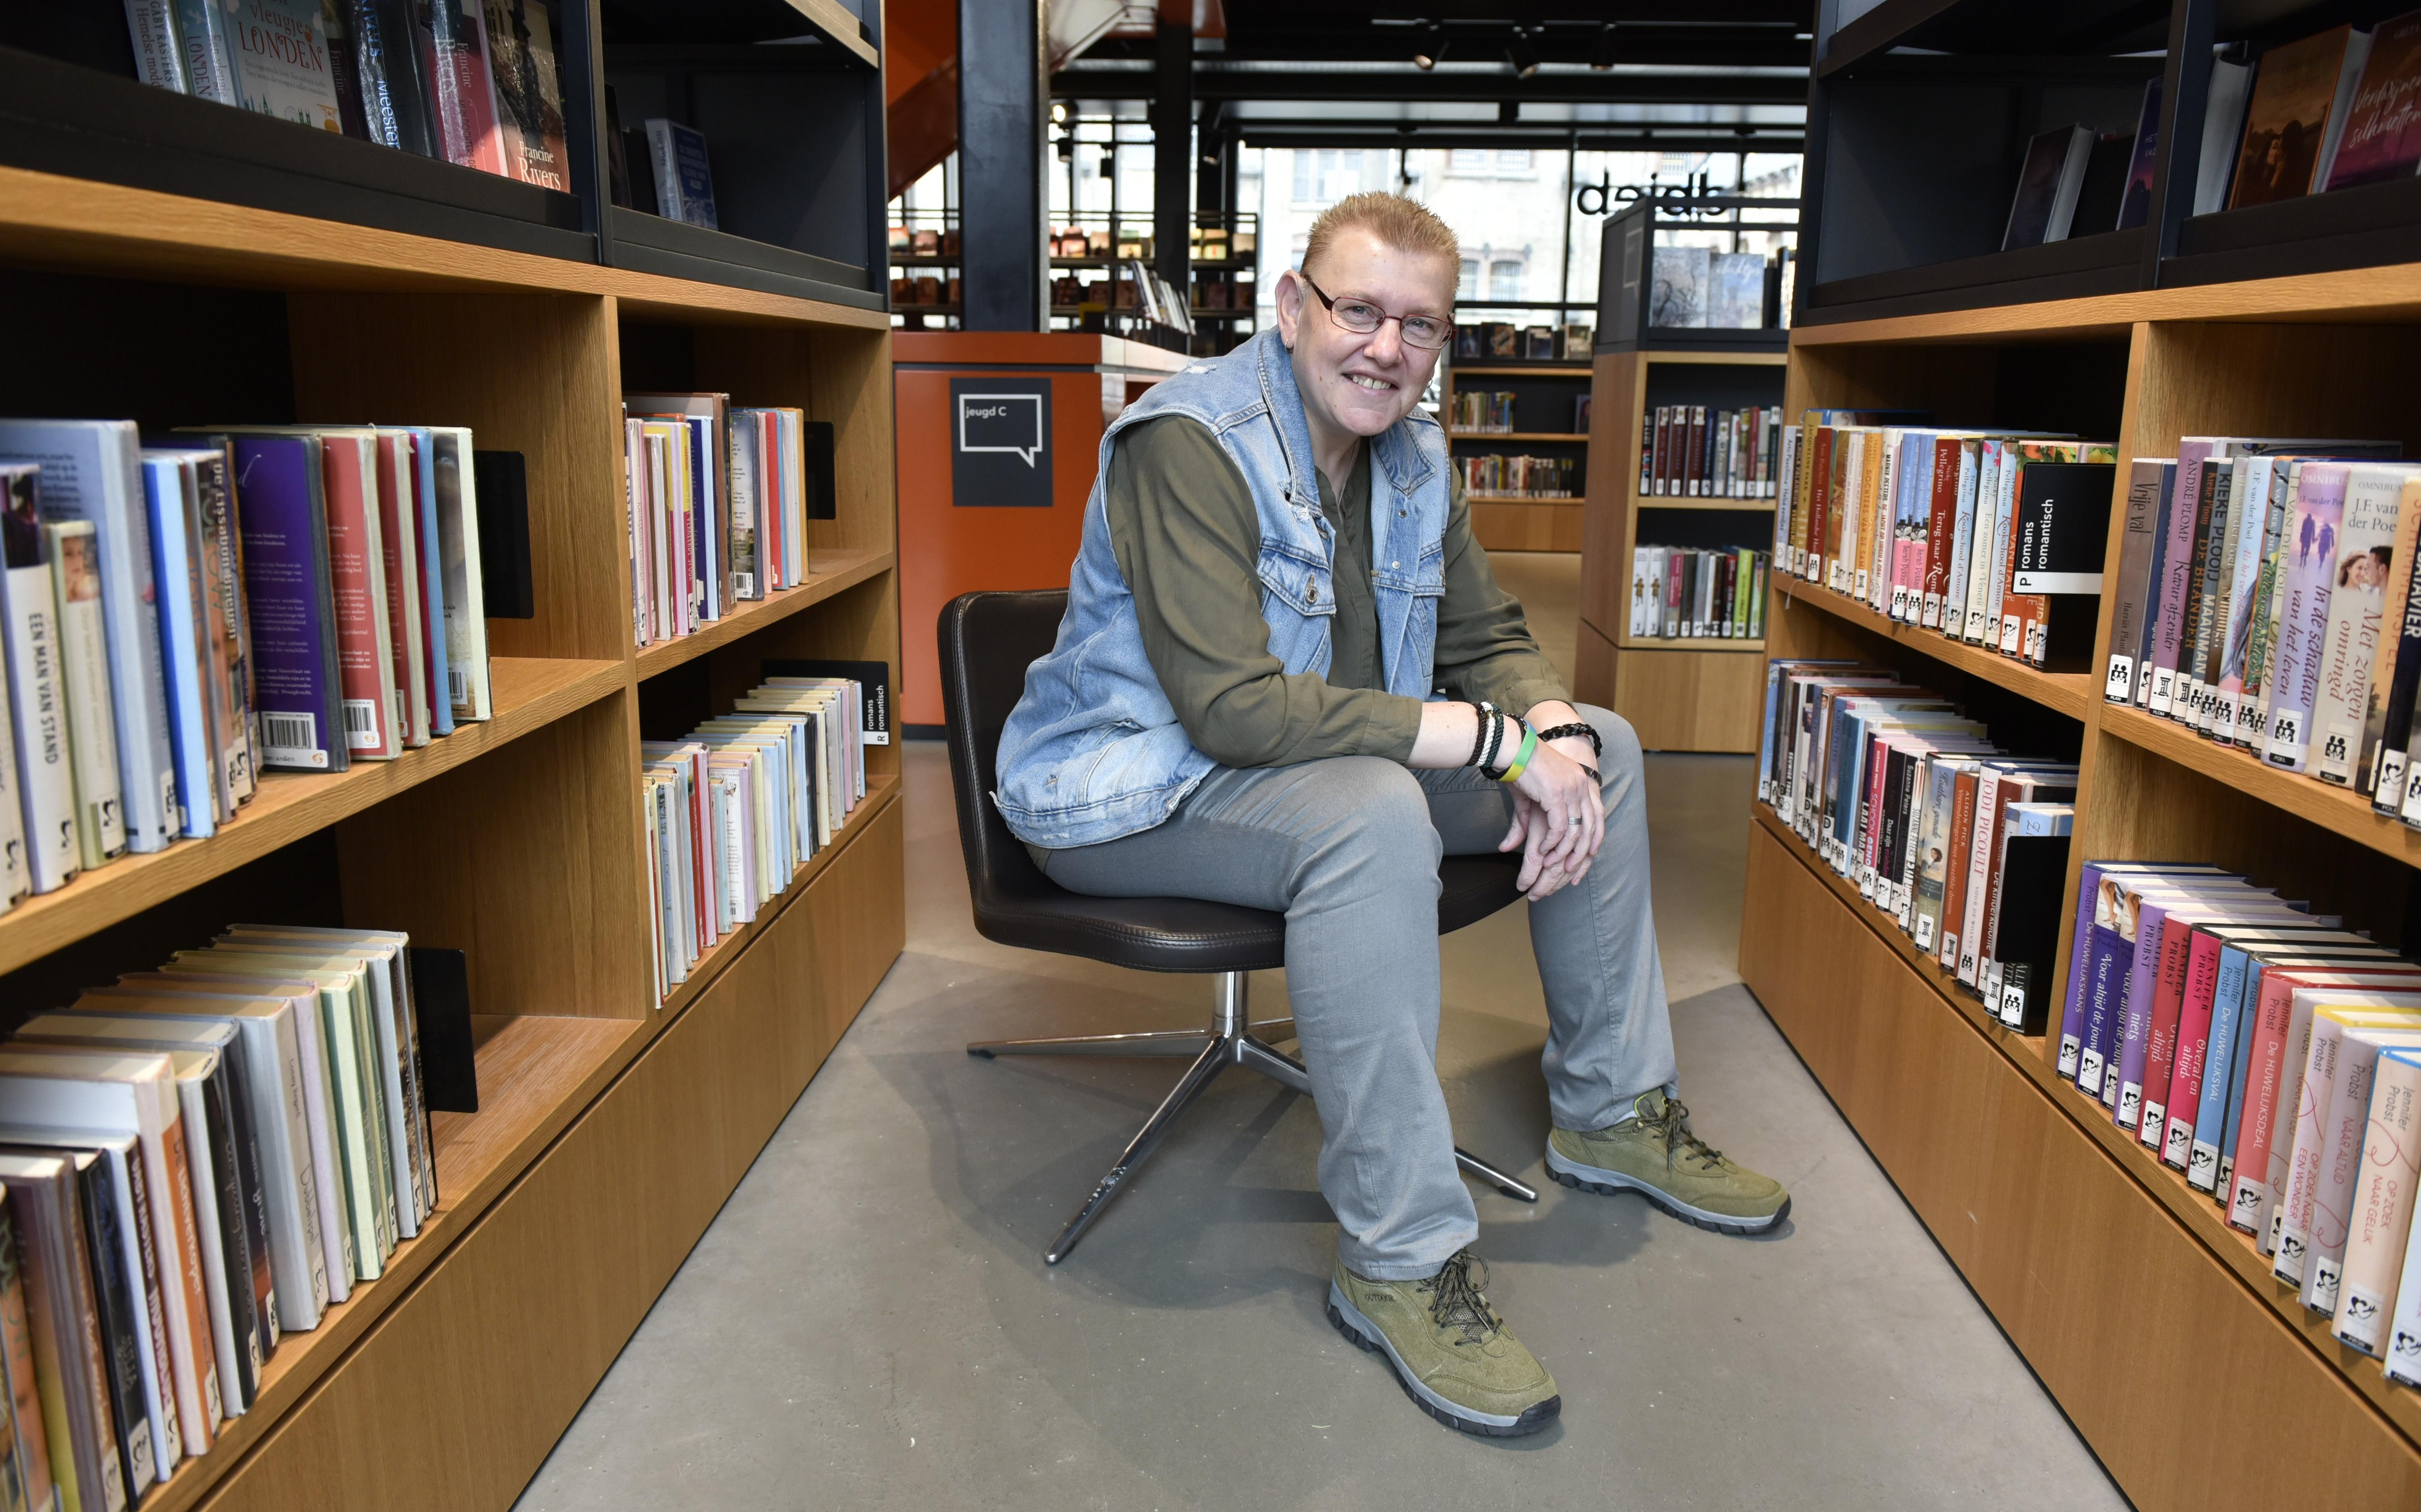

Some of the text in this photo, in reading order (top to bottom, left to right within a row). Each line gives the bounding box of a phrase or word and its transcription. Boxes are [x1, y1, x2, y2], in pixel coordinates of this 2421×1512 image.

[137, 8, 154, 54] Hemelse
[250, 0, 303, 36] vleugje
[187, 35, 212, 96] LONDEN
[239, 21, 323, 72] LONDEN
[457, 42, 473, 88] Francine
[518, 157, 561, 191] Rivers
[519, 141, 554, 163] Francine
[965, 406, 1006, 419] jeugd C
[1863, 469, 1872, 514] DOCHTERS
[1936, 449, 1948, 493] Pellegrino
[1961, 468, 1970, 503] Pellegrino
[1983, 468, 1992, 505] Pellegrino
[2002, 470, 2011, 507] Pellegrino
[2358, 482, 2402, 492] OMNIBUS
[2128, 483, 2158, 534] Vrije val
[2179, 458, 2198, 542] ANDRÉ PLOMP
[2215, 472, 2231, 519] KIEKE
[2245, 487, 2257, 540] van der Poel
[2353, 497, 2398, 514] J.F. van
[1933, 510, 1946, 560] Terug naar
[2021, 522, 2035, 569] romans
[2037, 499, 2054, 569] romantisch
[2349, 516, 2368, 529] der
[1955, 510, 1971, 600] Kookschool d'Amore
[1995, 515, 2011, 608] Kookschool d'Amore
[2207, 526, 2225, 582] PLOOIJ
[2276, 499, 2296, 599] VAN DER POEL
[2020, 577, 2031, 586] P
[2120, 602, 2132, 630] Harriët
[2163, 560, 2191, 652] Retour afzender
[2194, 594, 2216, 674] MAANMAN
[2279, 590, 2304, 695] van het leven
[2300, 606, 2327, 708] de schaduw
[2327, 620, 2351, 703] omringd
[2347, 607, 2382, 720] Met zorgen
[29, 613, 58, 765] EEN MAN VAN STAND
[876, 685, 884, 730] romantisch
[1868, 792, 1878, 834] SCHOON
[1902, 765, 1914, 815] Suzanne Peters
[1932, 771, 1949, 840] Kostbare genade
[1912, 808, 1921, 834] SUZANNE
[1953, 789, 1964, 843] Vreemdelingen
[1974, 778, 1994, 878] JODI PICOULT
[1949, 858, 1958, 889] dezelfde
[2084, 885, 2094, 912] Probst
[2075, 922, 2094, 1014] De HUWELIJKSKANS
[2141, 924, 2155, 969] PROBST
[2165, 941, 2179, 987] PROBST
[2093, 953, 2112, 1024] Voor altijd de
[2193, 955, 2206, 998] PROBST
[2201, 950, 2215, 1011] JENNIFER
[2220, 966, 2233, 997] Probst
[2230, 966, 2244, 1005] Jennifer
[2126, 1013, 2140, 1041] niets
[2266, 998, 2279, 1031] Probst
[2278, 998, 2292, 1038] Jennifer
[2151, 1029, 2166, 1062] altijd
[2180, 1045, 2192, 1079] altijd
[2190, 1039, 2206, 1095] Overal en
[2209, 1007, 2231, 1102] De HUWELIJKSVAL
[2314, 1038, 2327, 1072] Probst
[2324, 1038, 2337, 1081] Jennifer
[2083, 1087, 2093, 1095] PROB
[2254, 1041, 2278, 1149] De HUWELIJKSDEAL
[2347, 1064, 2365, 1100] Probst
[2384, 1086, 2400, 1123] Probst
[2398, 1085, 2415, 1132] Jennifer
[2339, 1116, 2355, 1148] NAAR
[2169, 1161, 2181, 1170] PROB
[2191, 1183, 2204, 1192] PROB
[2292, 1147, 2308, 1219] EEN WONDER
[2300, 1153, 2319, 1231] OP ZOEK NAAR
[2363, 1174, 2383, 1246] NAAR GELUK
[2380, 1179, 2398, 1231] OP ZOEK
[2237, 1223, 2252, 1233] PROB
